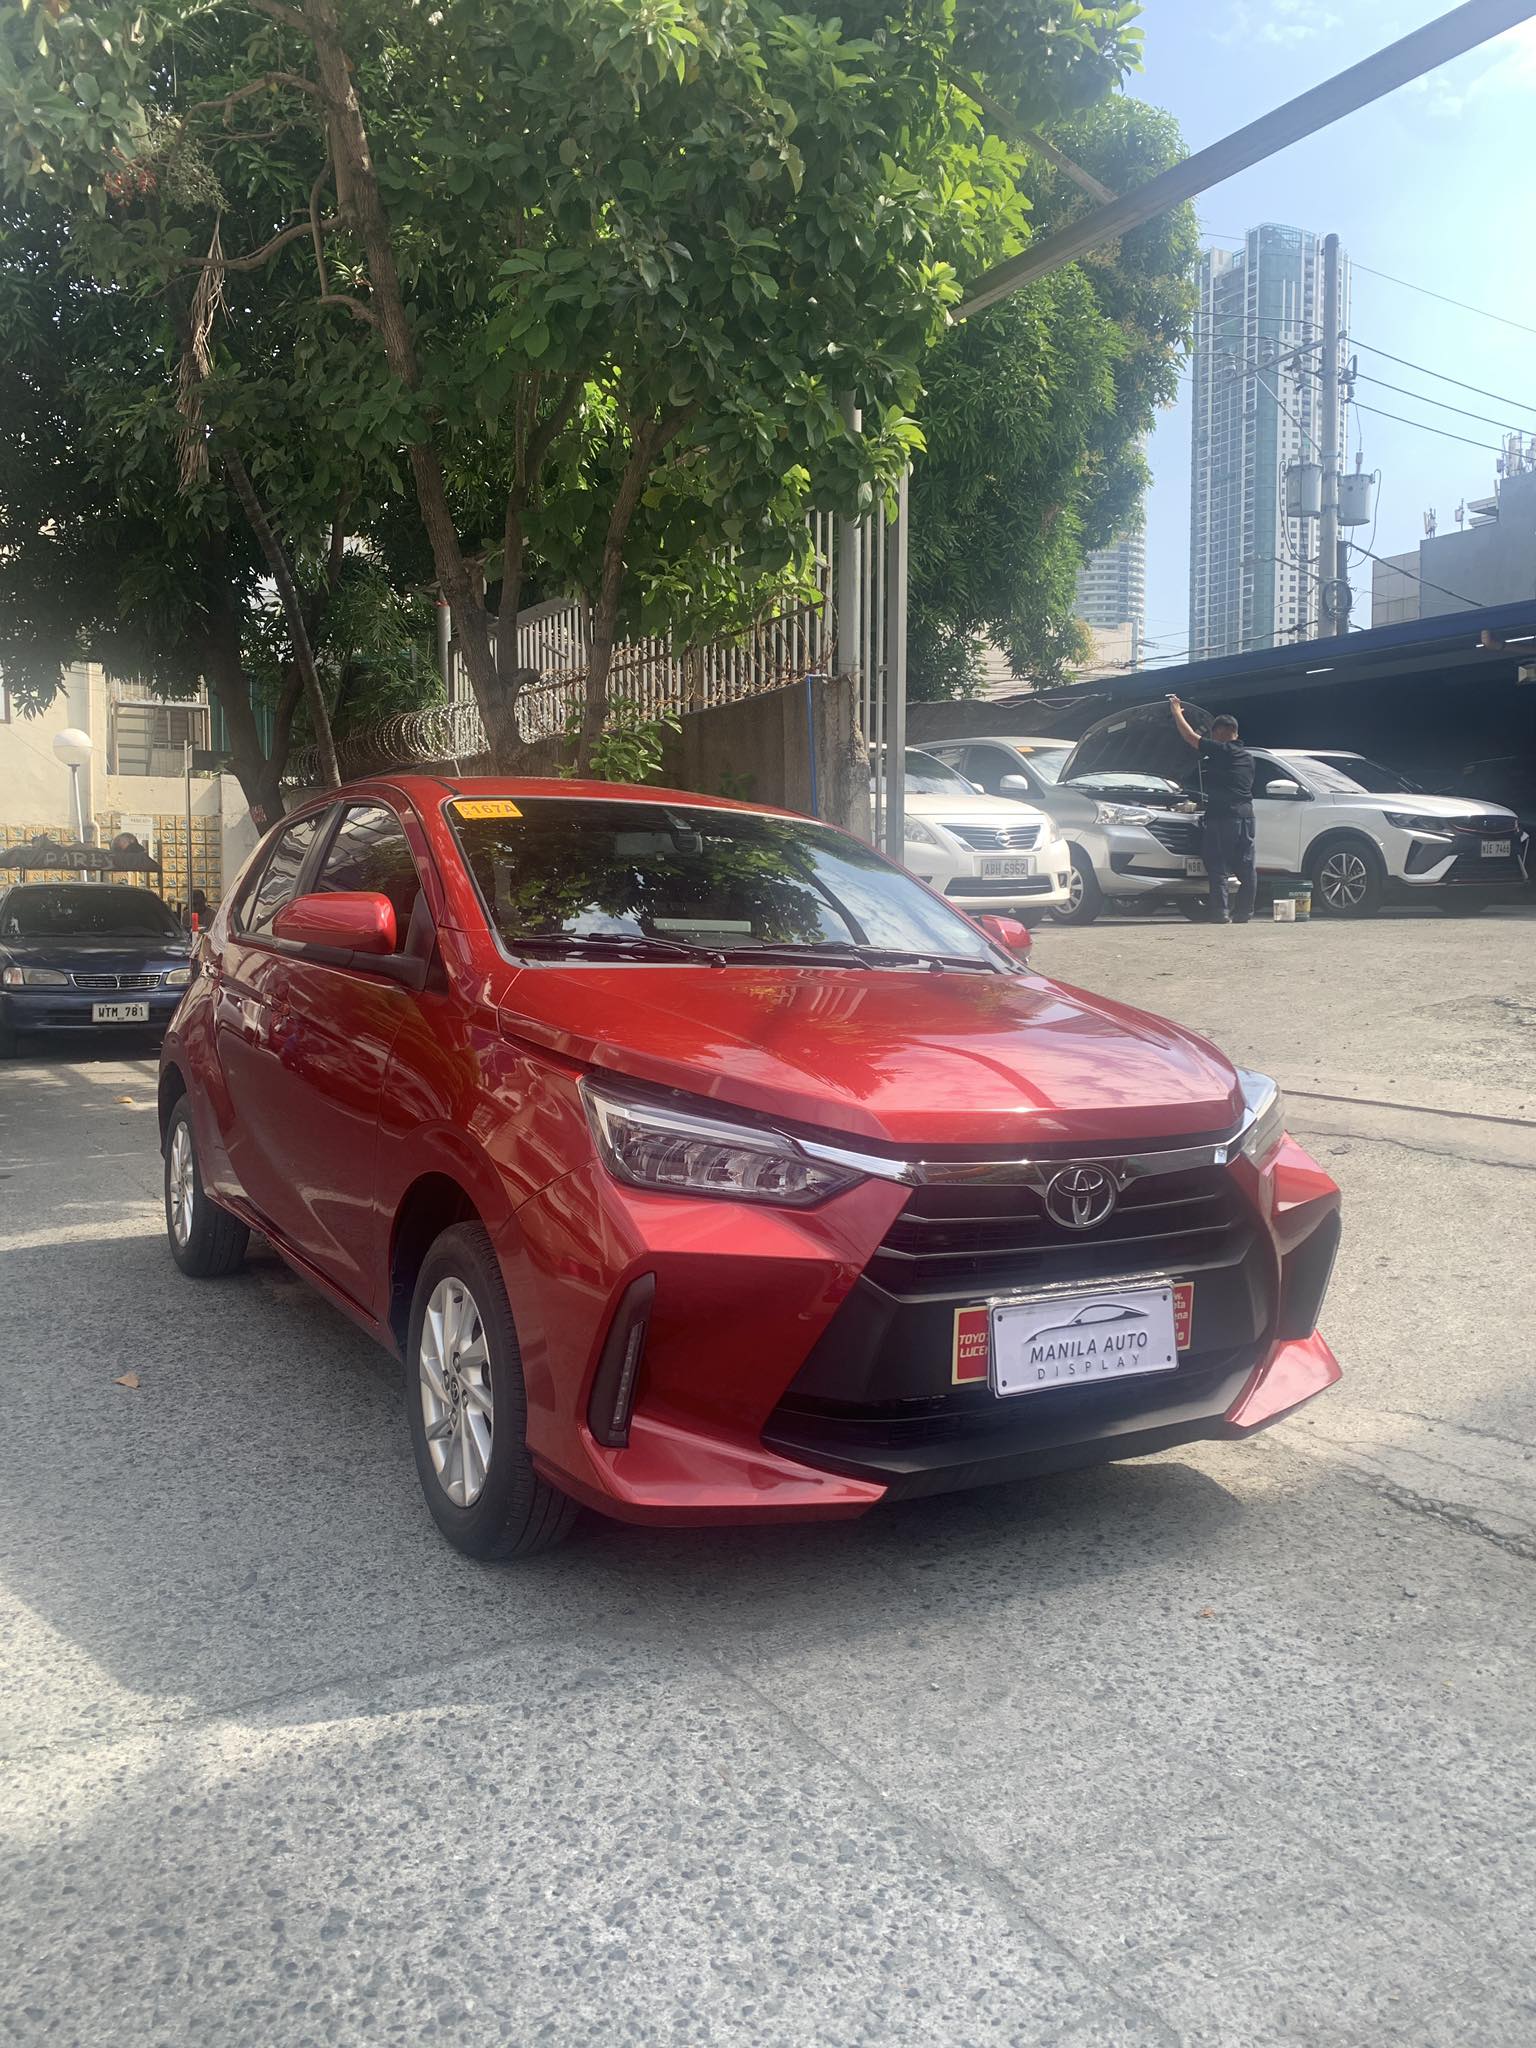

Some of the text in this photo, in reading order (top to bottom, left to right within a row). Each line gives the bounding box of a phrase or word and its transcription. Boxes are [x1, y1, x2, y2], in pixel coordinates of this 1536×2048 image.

[98, 1006, 144, 1018] WTM 781
[959, 1332, 987, 1345] TOYO
[1030, 1331, 1148, 1363] MANILA AUTO
[1037, 1354, 1140, 1380] DISPLAY
